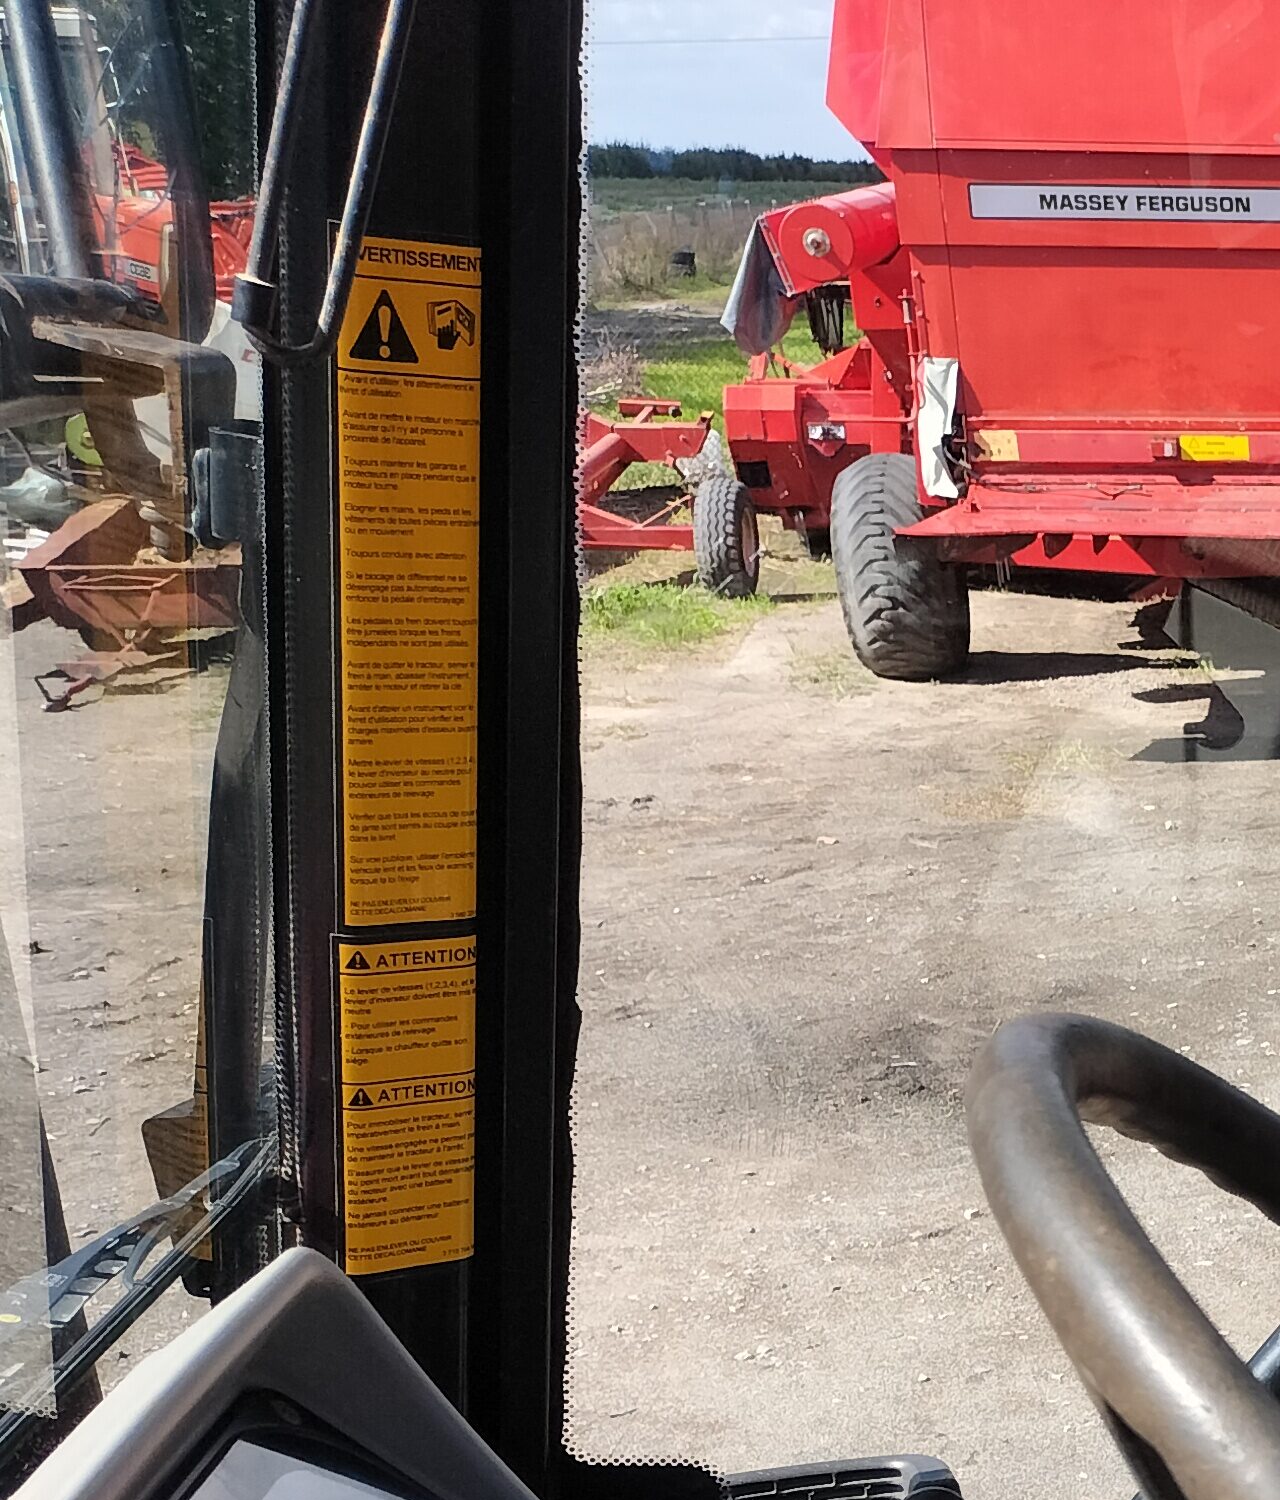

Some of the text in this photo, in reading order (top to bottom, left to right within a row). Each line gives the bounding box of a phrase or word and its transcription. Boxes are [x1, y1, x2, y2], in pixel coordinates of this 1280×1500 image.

[1039, 194, 1251, 213] MASSEY FERGUSON
[358, 246, 481, 272] VERTISSEMENT
[376, 946, 476, 968] ATTENTION
[378, 1079, 475, 1102] ATTENTION
